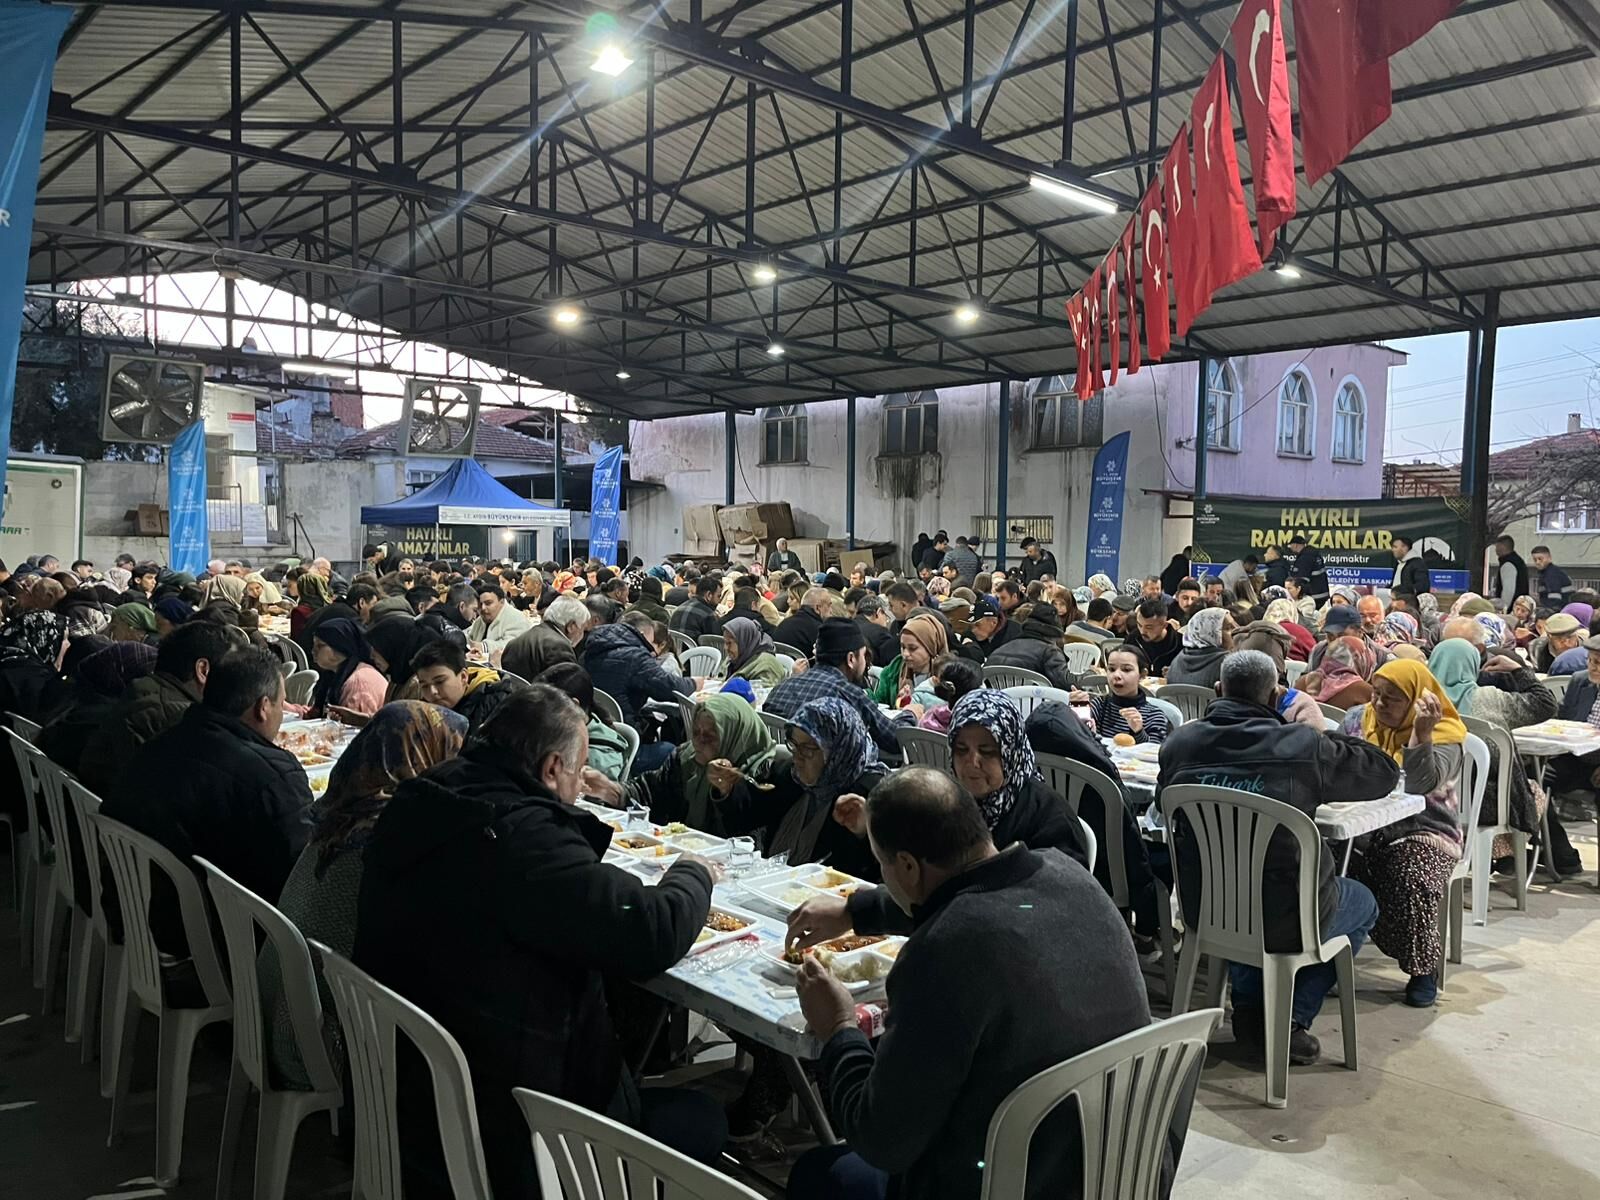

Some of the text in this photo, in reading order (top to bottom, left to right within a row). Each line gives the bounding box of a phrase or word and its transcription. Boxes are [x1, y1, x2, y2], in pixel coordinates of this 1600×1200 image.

[1281, 507, 1360, 527] HAYIRLI
[406, 527, 452, 540] HAYIRLI
[397, 541, 470, 555] AMAZANLAR
[1323, 554, 1369, 564] ylaşmaktır
[1326, 568, 1360, 577] ÇİOĞLU
